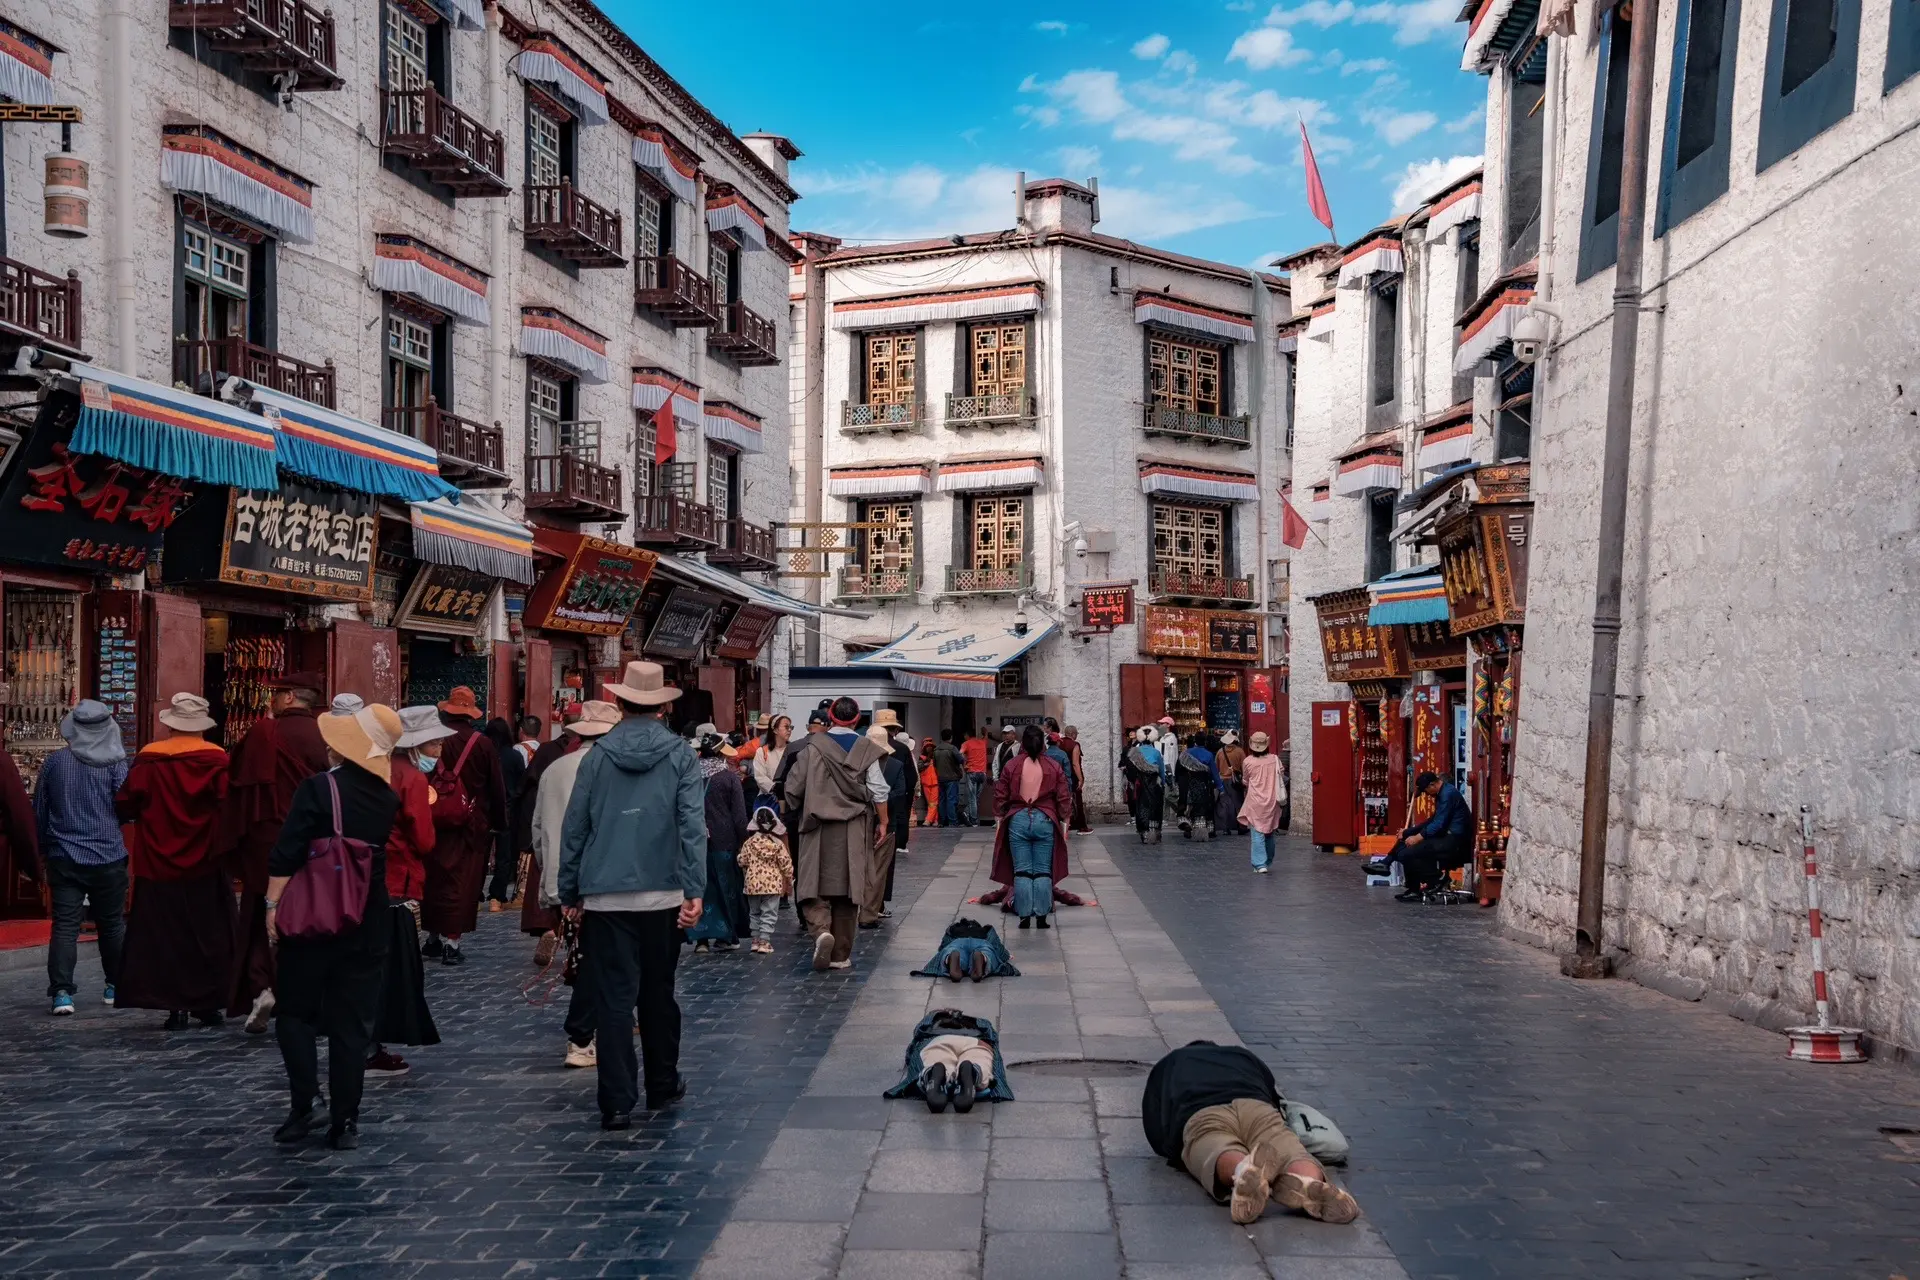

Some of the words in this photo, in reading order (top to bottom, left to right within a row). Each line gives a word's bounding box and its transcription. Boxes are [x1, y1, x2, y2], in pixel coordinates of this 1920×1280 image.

[234, 489, 374, 563] 古城老珠宝店
[1087, 594, 1124, 608] 安全出口
[1326, 626, 1377, 653] 格桑梅朵
